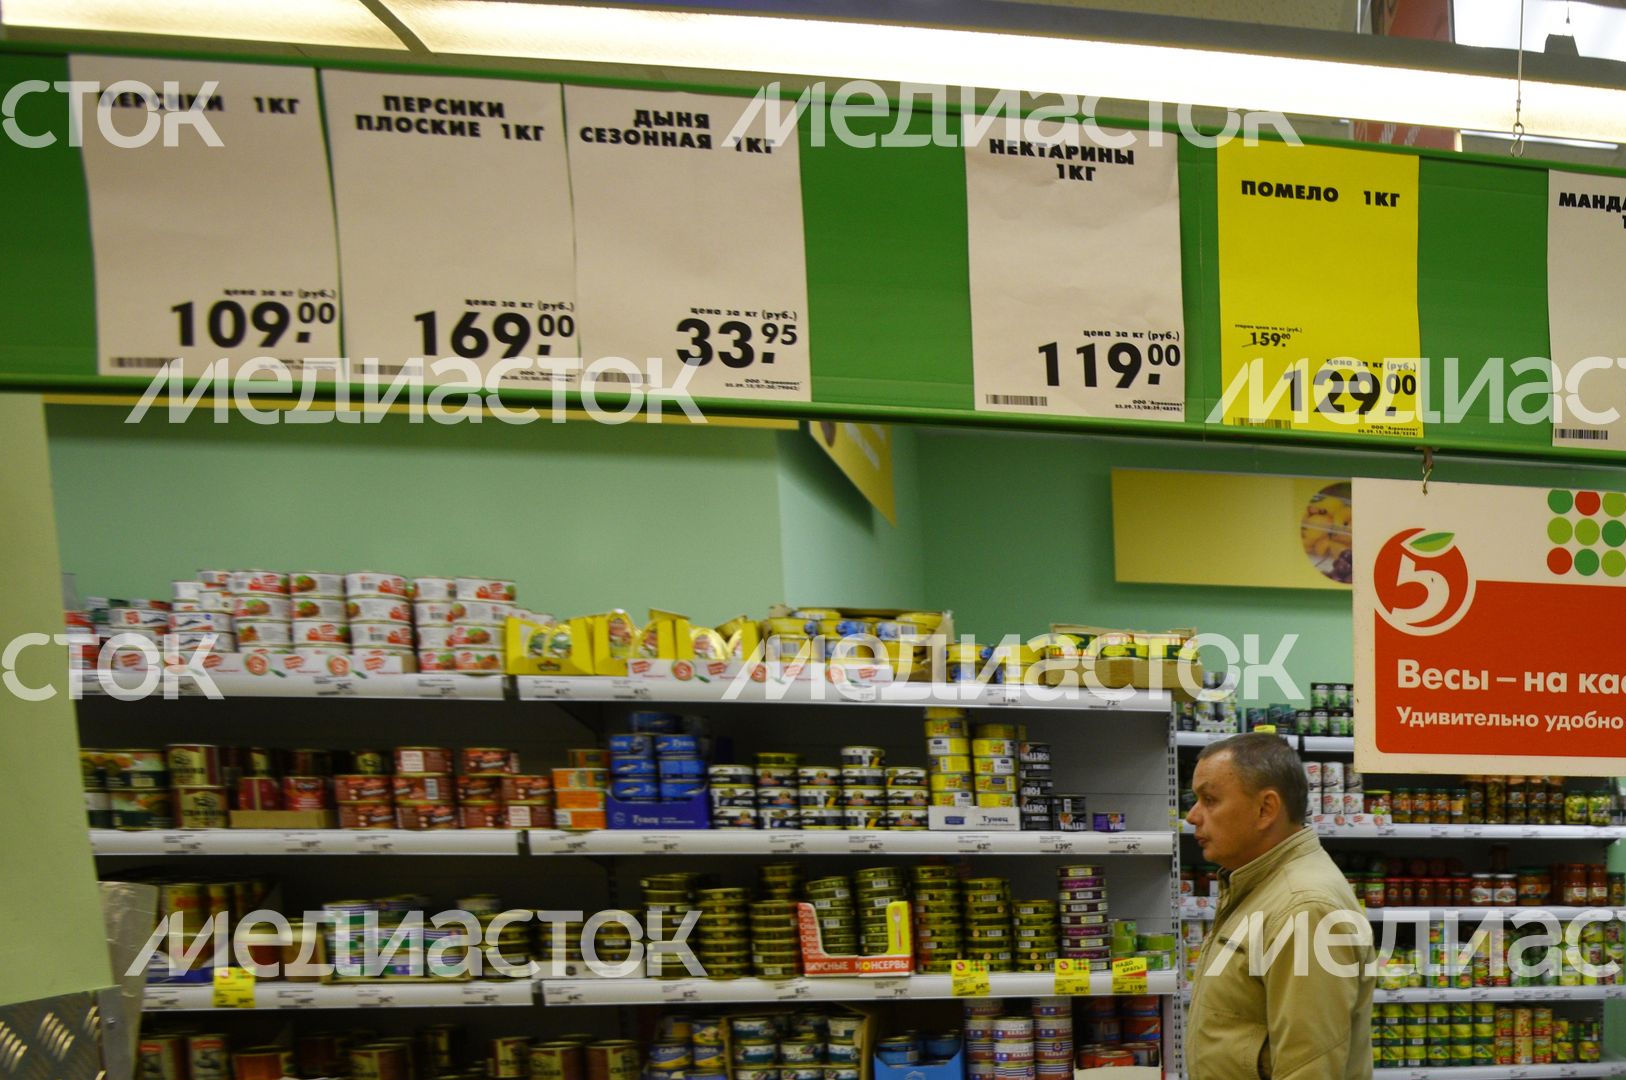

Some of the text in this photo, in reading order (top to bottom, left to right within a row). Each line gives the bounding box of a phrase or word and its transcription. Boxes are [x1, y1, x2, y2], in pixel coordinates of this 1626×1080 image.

[254, 97, 299, 114] 1КГ
[383, 95, 505, 119] ПЕРСИКИ
[355, 114, 545, 142] ПЛОСКИЕ 1КГ
[633, 109, 711, 131] ДЫНЯ
[580, 127, 776, 155] СЕЗОННАЯ 1КГ
[989, 138, 1135, 165] НЕКТАРИНЫ
[1056, 163, 1096, 182] 1КГ
[1240, 180, 1402, 208] ПОМЕЛО 1КГ
[690, 307, 721, 316] цена
[726, 309, 740, 317] за
[762, 310, 798, 321] (руб.)
[1083, 330, 1111, 338] цена
[1132, 331, 1144, 339] кг
[1148, 330, 1180, 341] (руб.)
[1397, 658, 1489, 691] Весы
[1524, 670, 1568, 693] на
[1396, 706, 1539, 727] Удивительно
